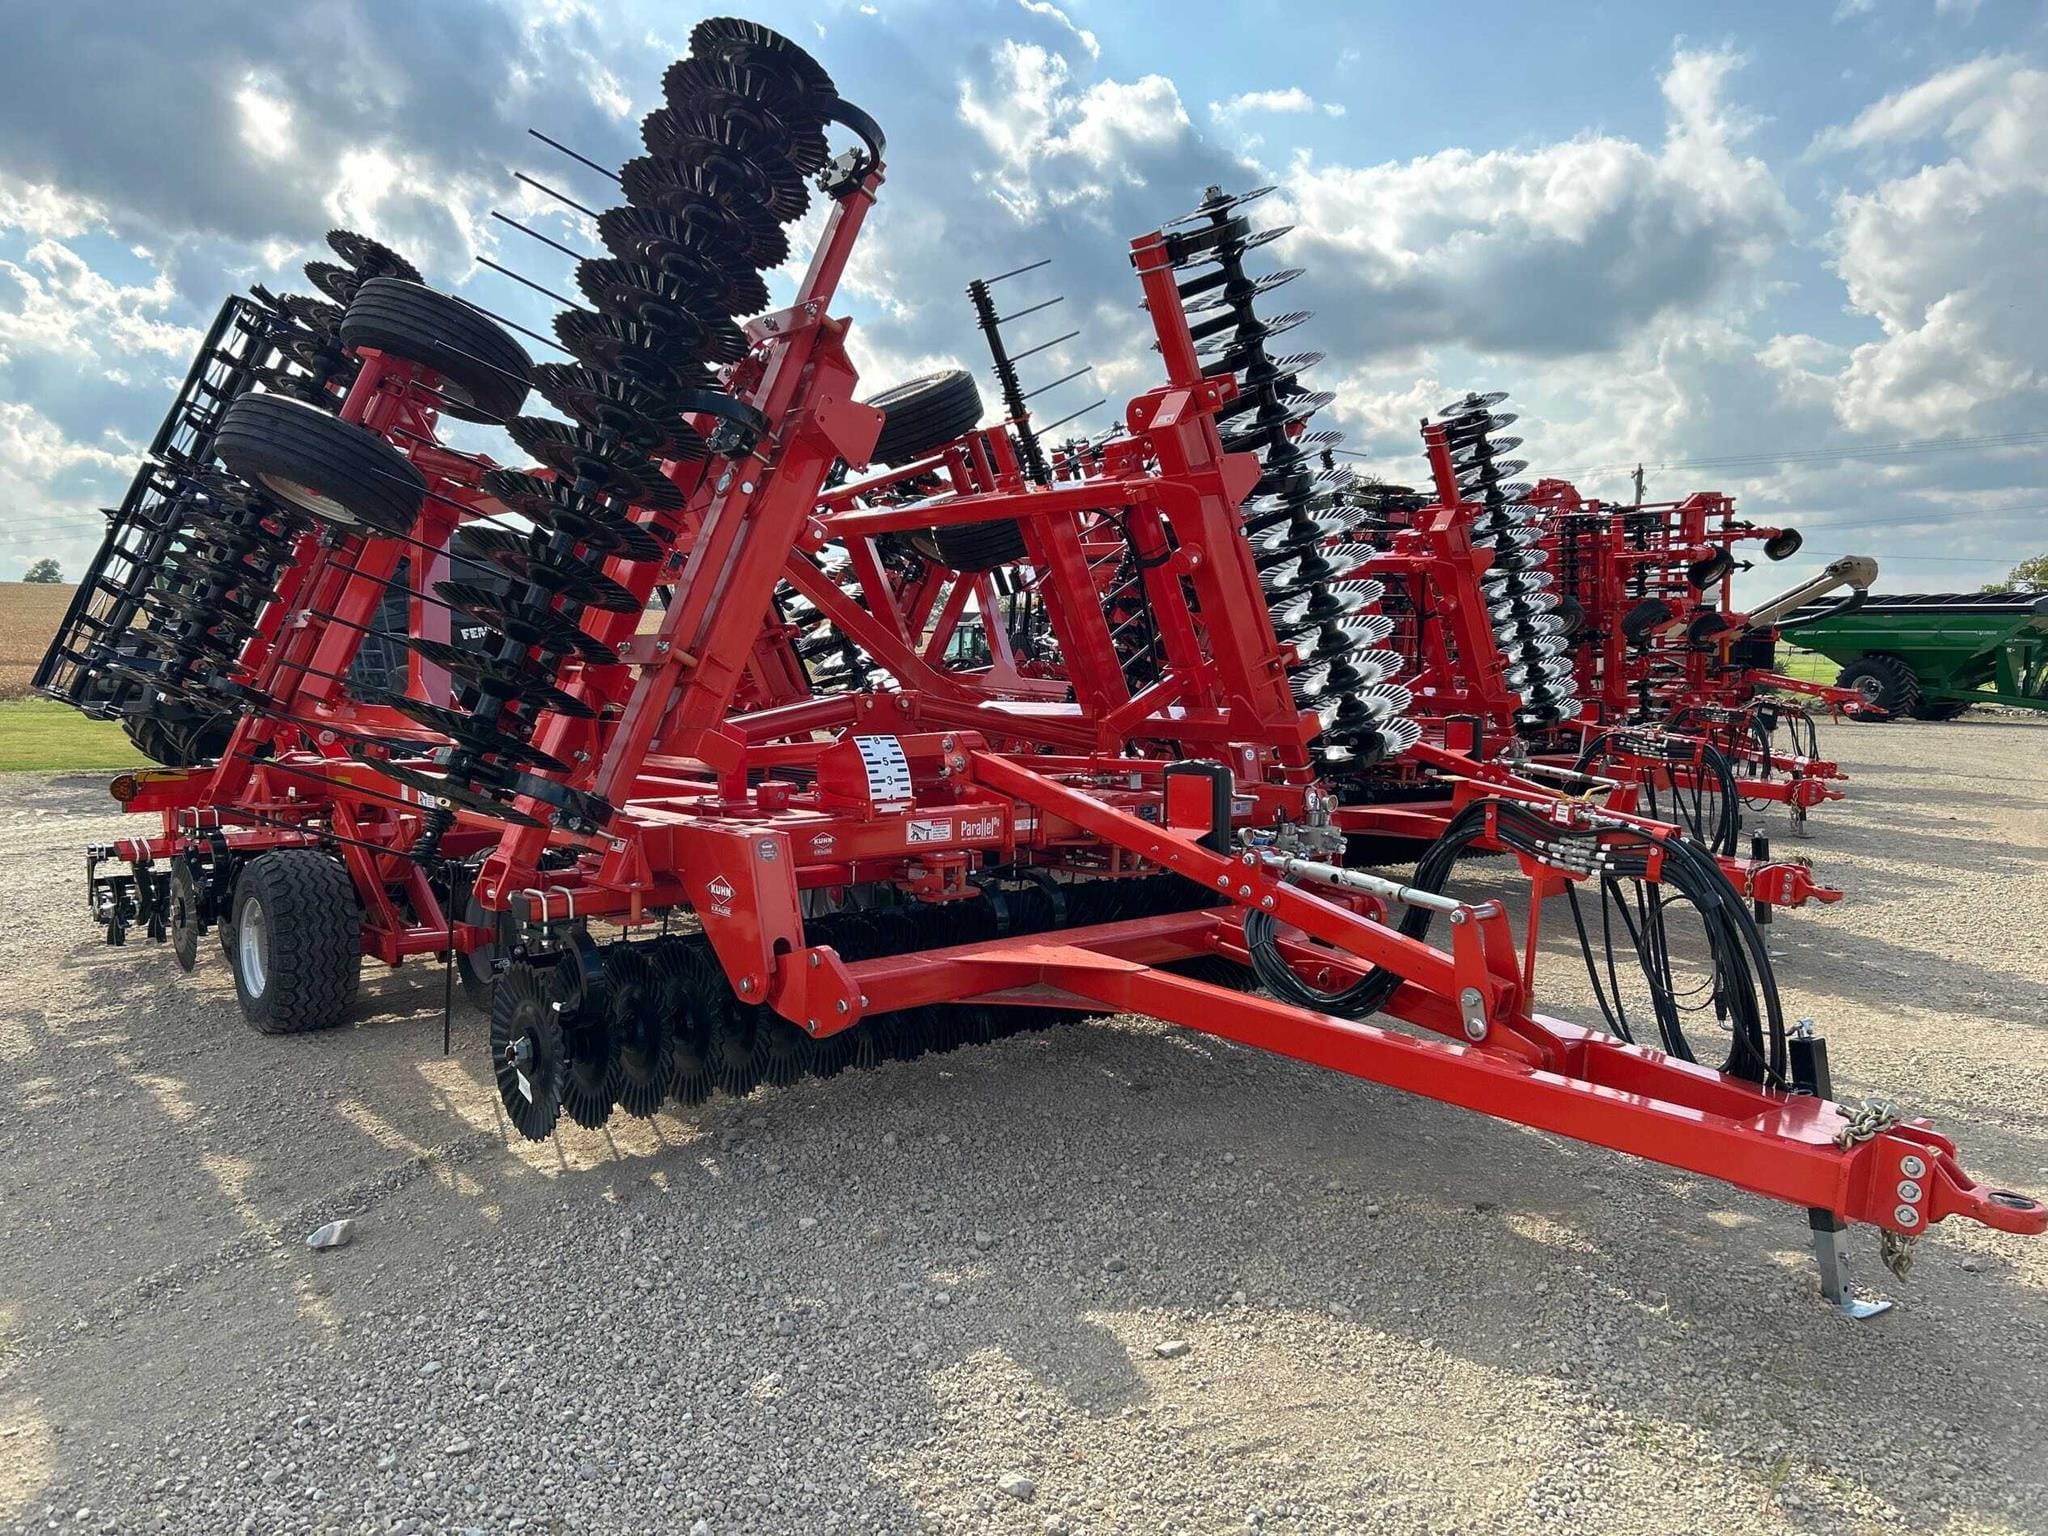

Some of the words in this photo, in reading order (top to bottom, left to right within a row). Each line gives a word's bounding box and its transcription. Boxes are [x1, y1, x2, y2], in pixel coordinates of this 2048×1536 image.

[882, 757, 890, 767] 5
[887, 776, 894, 786] 3
[961, 817, 995, 837] Parallel
[710, 884, 731, 897] KUHN
